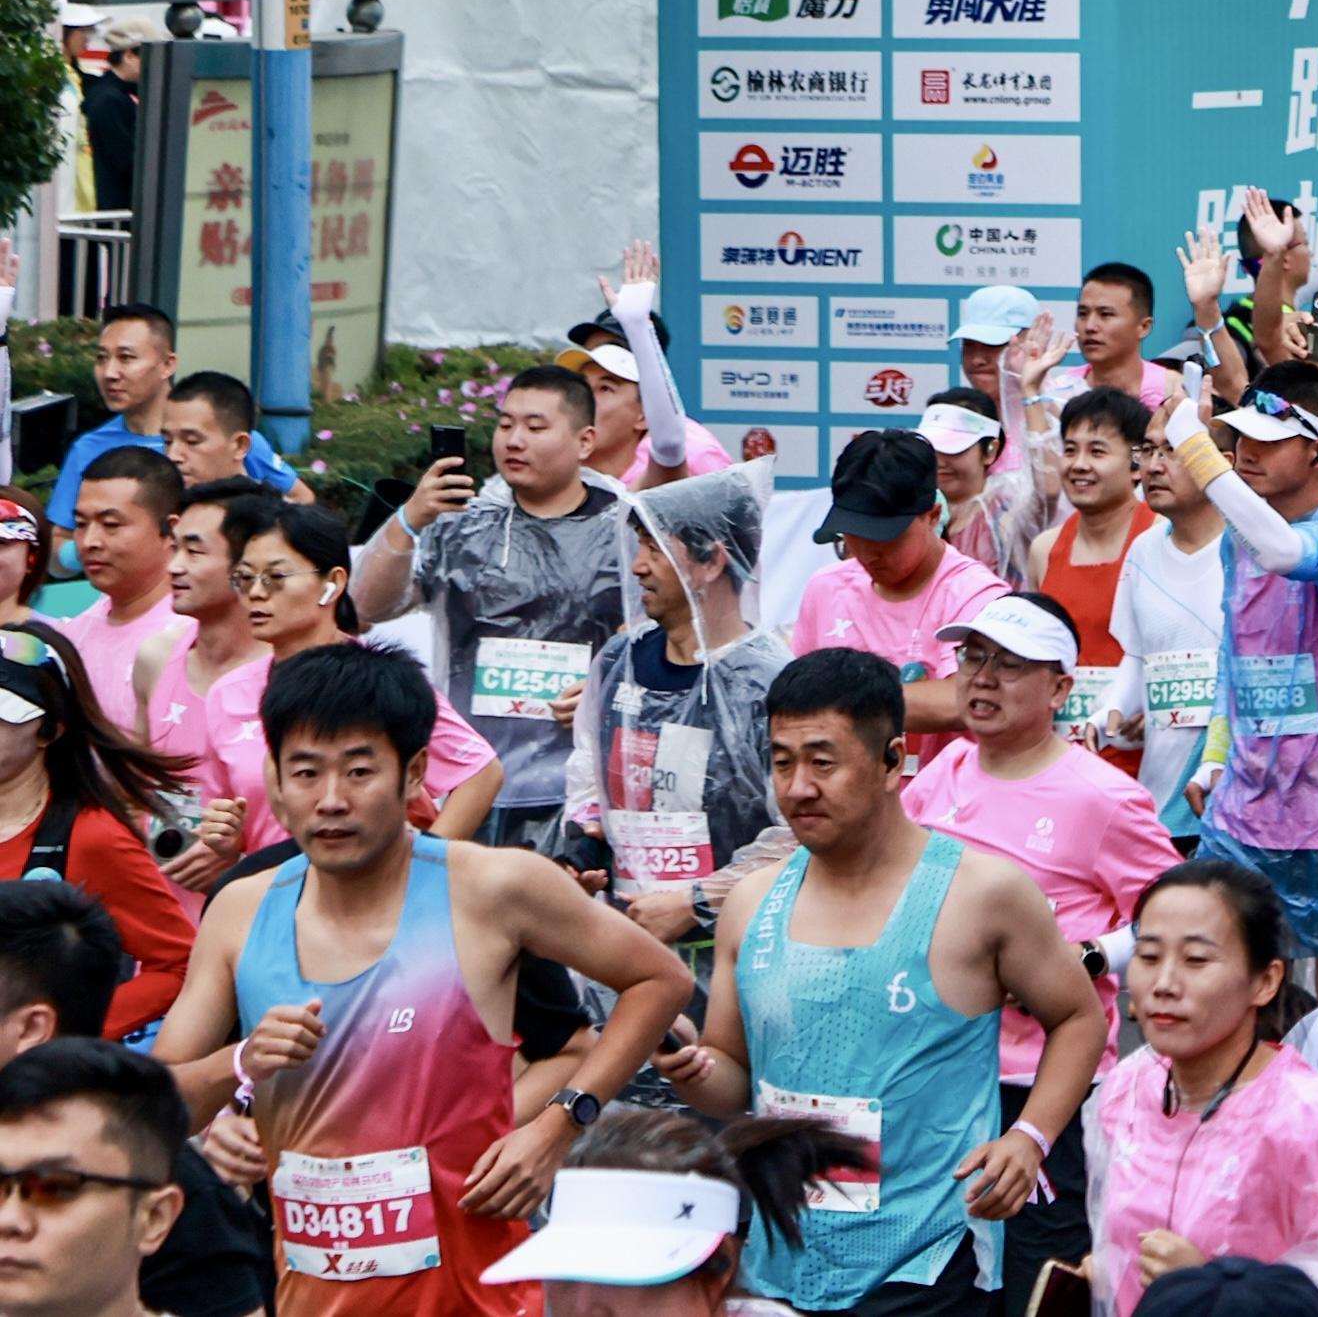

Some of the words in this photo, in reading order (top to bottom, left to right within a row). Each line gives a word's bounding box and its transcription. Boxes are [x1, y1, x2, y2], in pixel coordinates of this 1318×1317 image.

[746, 68, 869, 94] 榆林农商银行
[779, 146, 847, 178] 迈胜
[968, 227, 1039, 243] 中国人寿
[968, 246, 1007, 257] CHINA
[1010, 245, 1037, 257] LIFE
[720, 371, 772, 386] BYD
[751, 864, 799, 971] FLIPBELT
[284, 1199, 414, 1241] D34817
